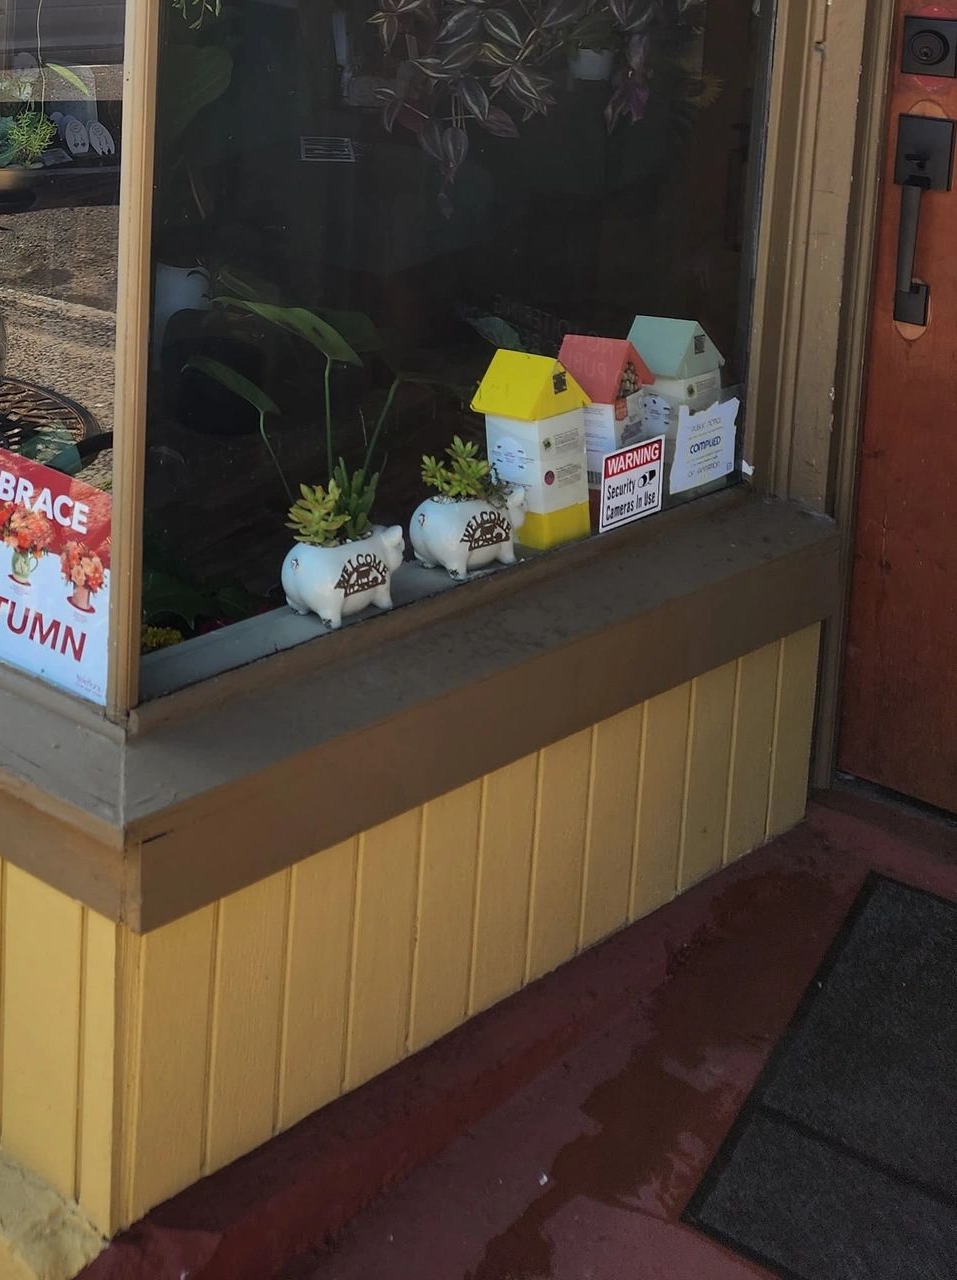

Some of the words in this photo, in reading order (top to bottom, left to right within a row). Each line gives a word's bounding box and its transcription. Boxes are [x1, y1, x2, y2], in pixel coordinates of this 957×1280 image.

[607, 443, 660, 476] WARNING
[605, 500, 635, 521] Cameras
[636, 495, 643, 510] In
[644, 491, 656, 507] Use
[606, 478, 636, 501] Security
[459, 511, 512, 544] WELCOME
[333, 553, 389, 590] WELCOME
